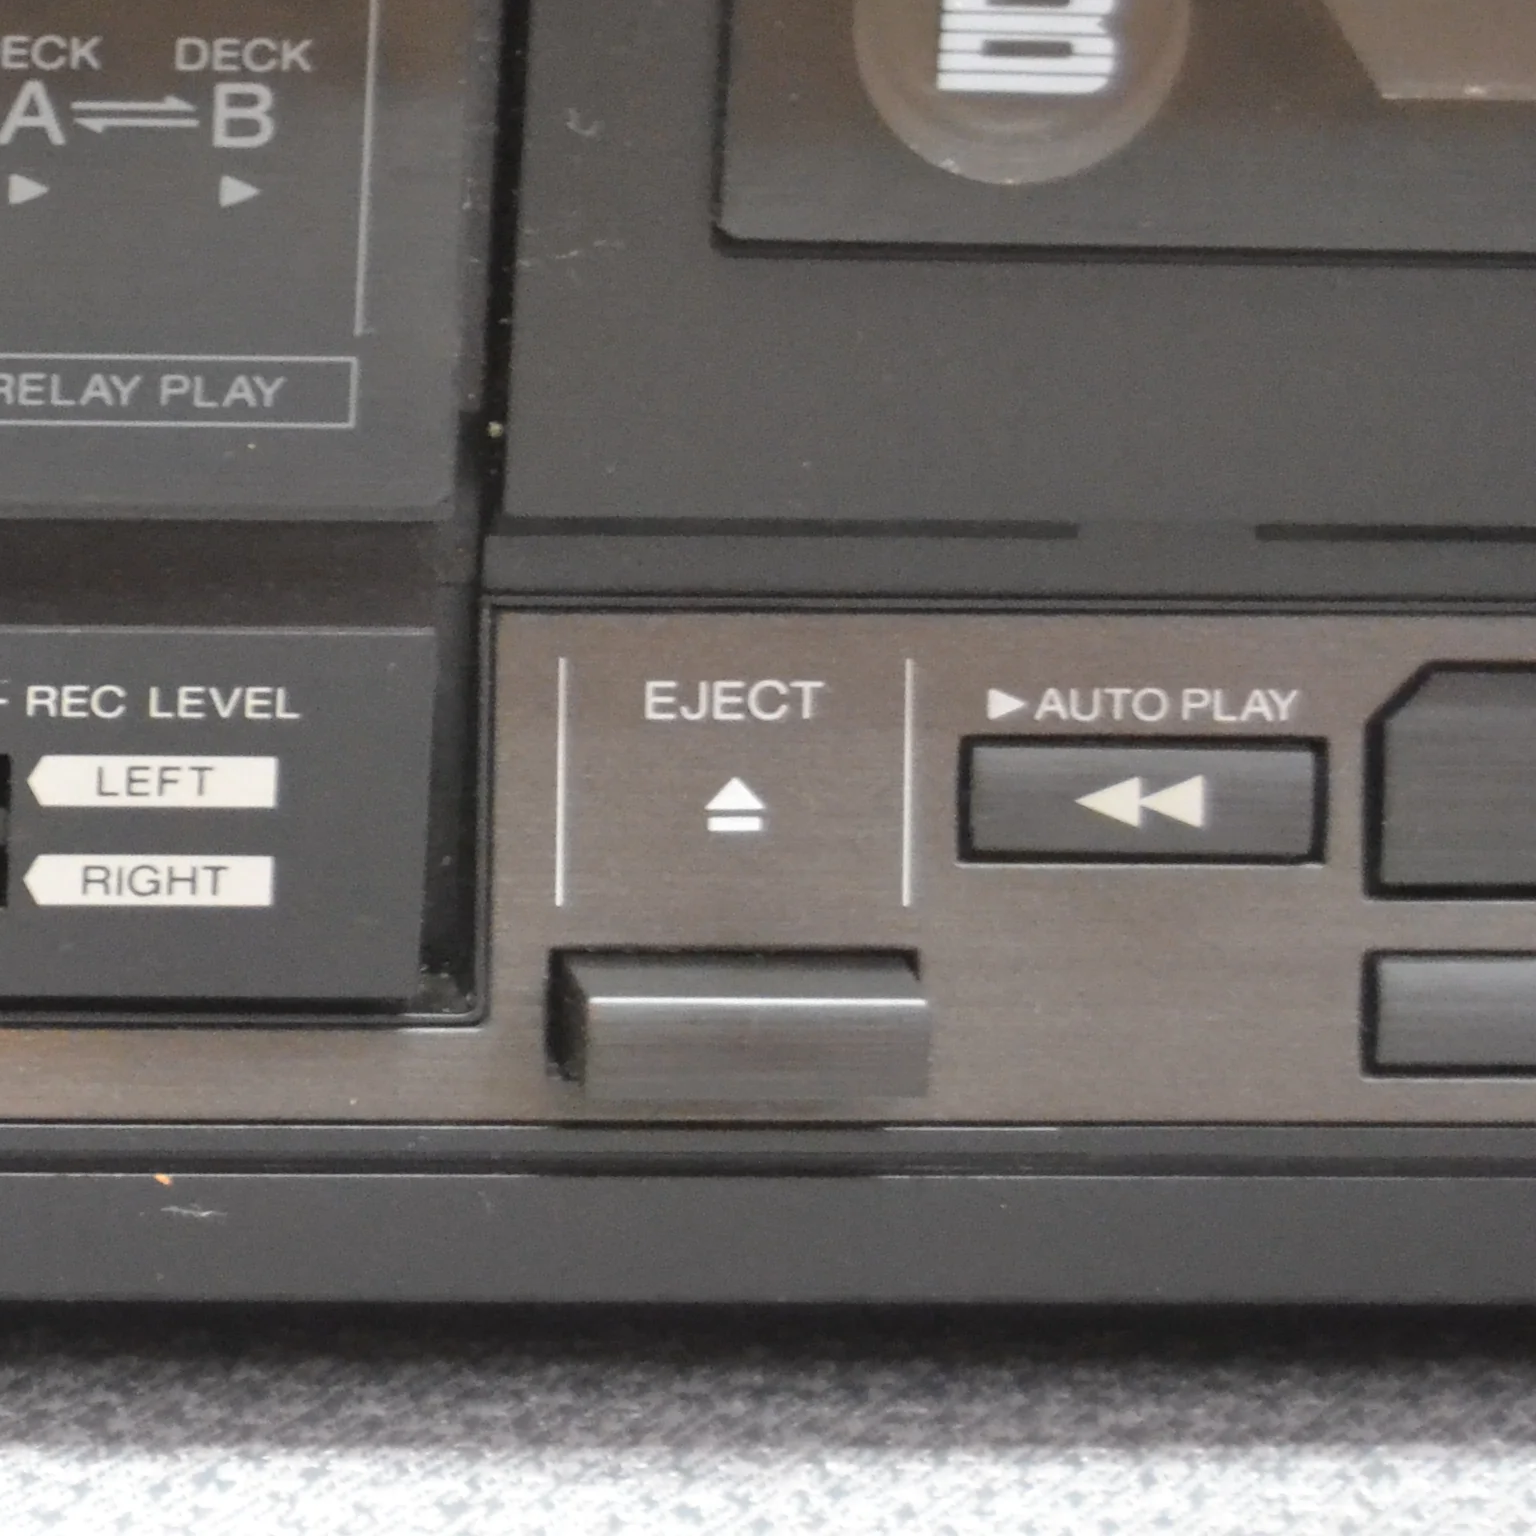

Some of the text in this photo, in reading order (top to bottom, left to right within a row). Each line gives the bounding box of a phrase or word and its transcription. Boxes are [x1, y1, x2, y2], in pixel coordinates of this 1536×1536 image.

[175, 37, 314, 73] DECK
[212, 82, 276, 149] B
[159, 374, 288, 408] PLAY
[26, 684, 301, 720] REC LEVEL
[644, 679, 825, 721] EJECT
[1034, 686, 1298, 723] AUTO PLAY
[96, 766, 214, 797] LEFT
[81, 865, 228, 897] RIGHT
